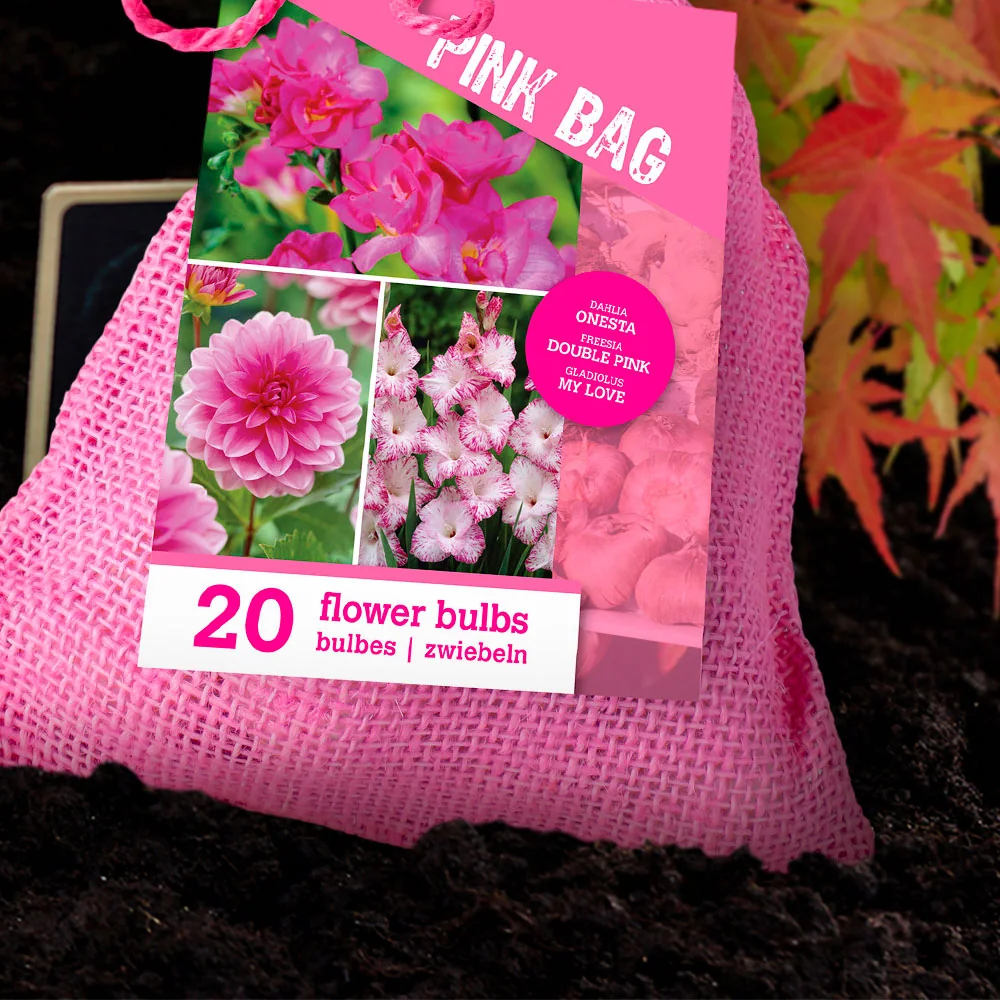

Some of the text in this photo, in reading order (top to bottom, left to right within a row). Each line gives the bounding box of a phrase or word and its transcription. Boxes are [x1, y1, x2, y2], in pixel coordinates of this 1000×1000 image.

[426, 14, 672, 185] PINK BAG
[575, 310, 636, 335] ONESTA
[590, 300, 628, 317] DAHLIA
[546, 338, 651, 374] DOUBLE PINK
[580, 333, 623, 351] FREESIA
[557, 377, 626, 404] MY LOVE
[565, 366, 625, 387] GLADIOLUS
[193, 584, 294, 653] 20
[319, 592, 530, 635] flower bulbs
[315, 632, 397, 658] bulbes
[424, 641, 528, 665] zwiebeln
